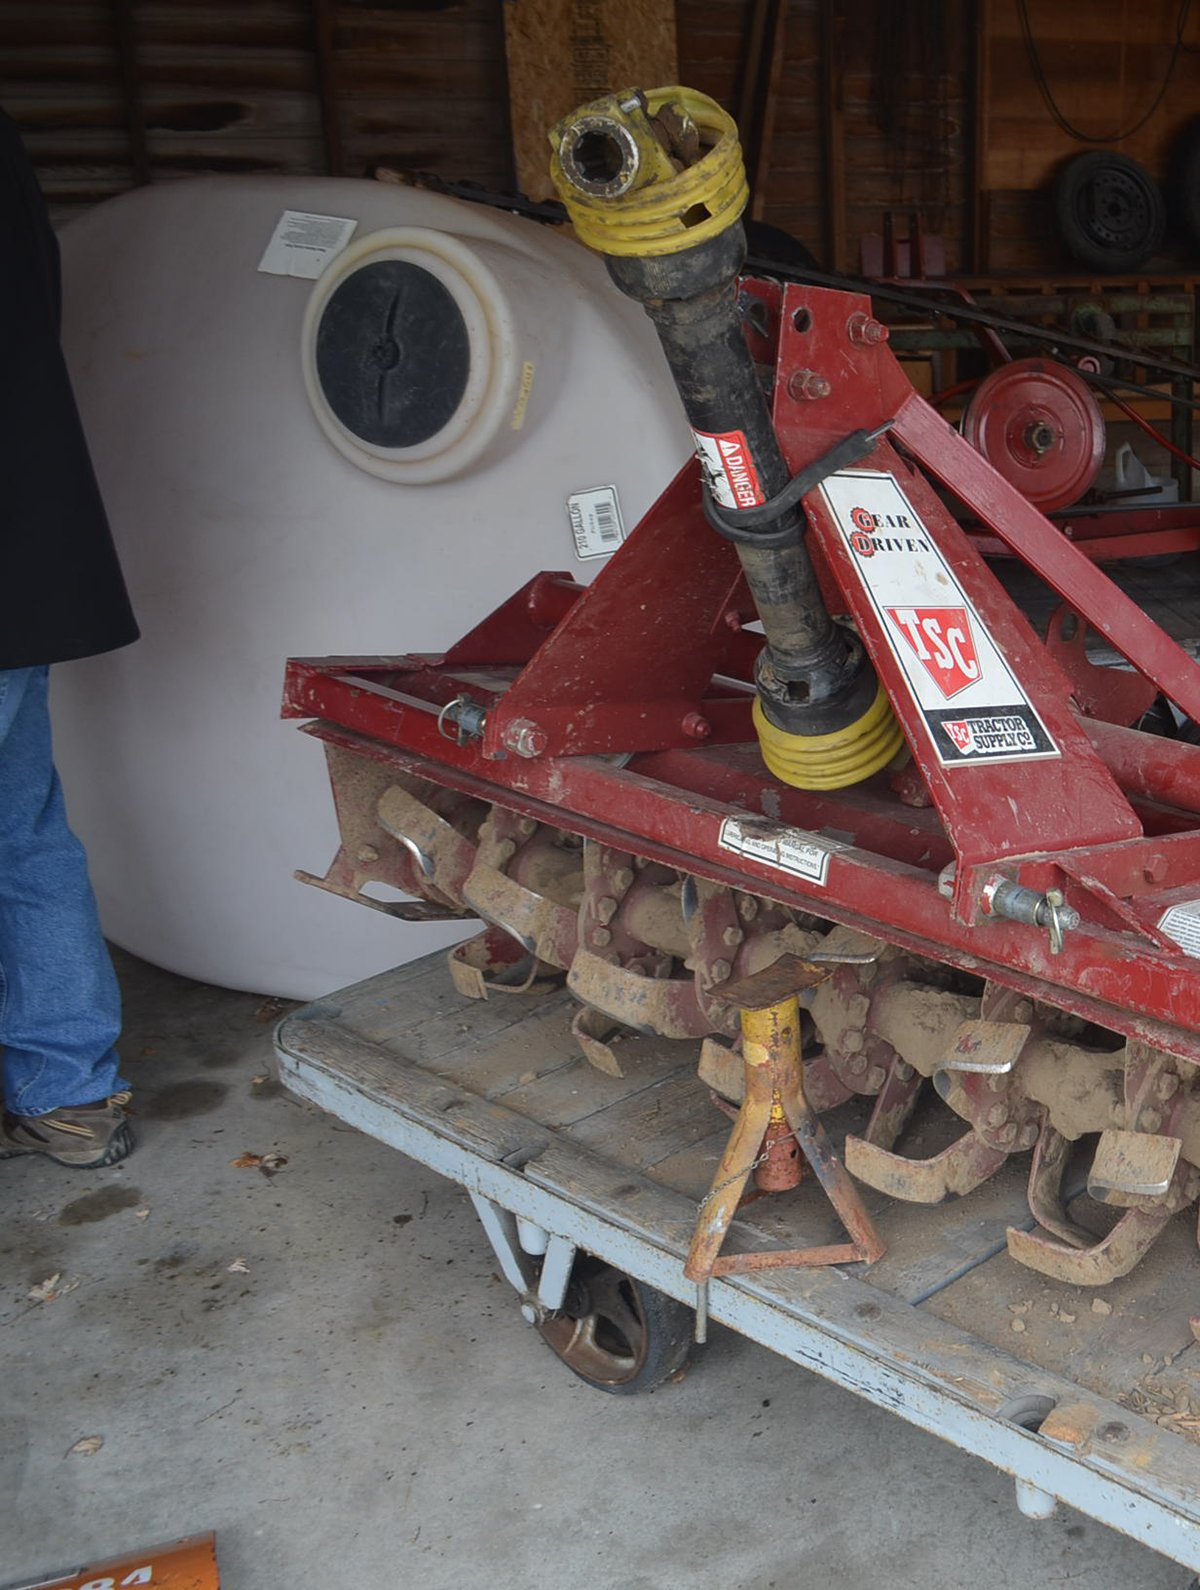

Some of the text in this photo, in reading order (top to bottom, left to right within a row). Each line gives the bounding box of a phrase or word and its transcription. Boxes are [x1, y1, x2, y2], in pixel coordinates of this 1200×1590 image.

[725, 455, 757, 507] DANGER
[570, 502, 589, 549] 210 GALLON
[857, 510, 911, 529] GEAR
[857, 536, 930, 553] DRIVEN
[894, 609, 979, 679] TSC
[947, 723, 970, 744] TSC
[966, 717, 1026, 734] TRACTOR
[973, 733, 1017, 750] SUPPLY
